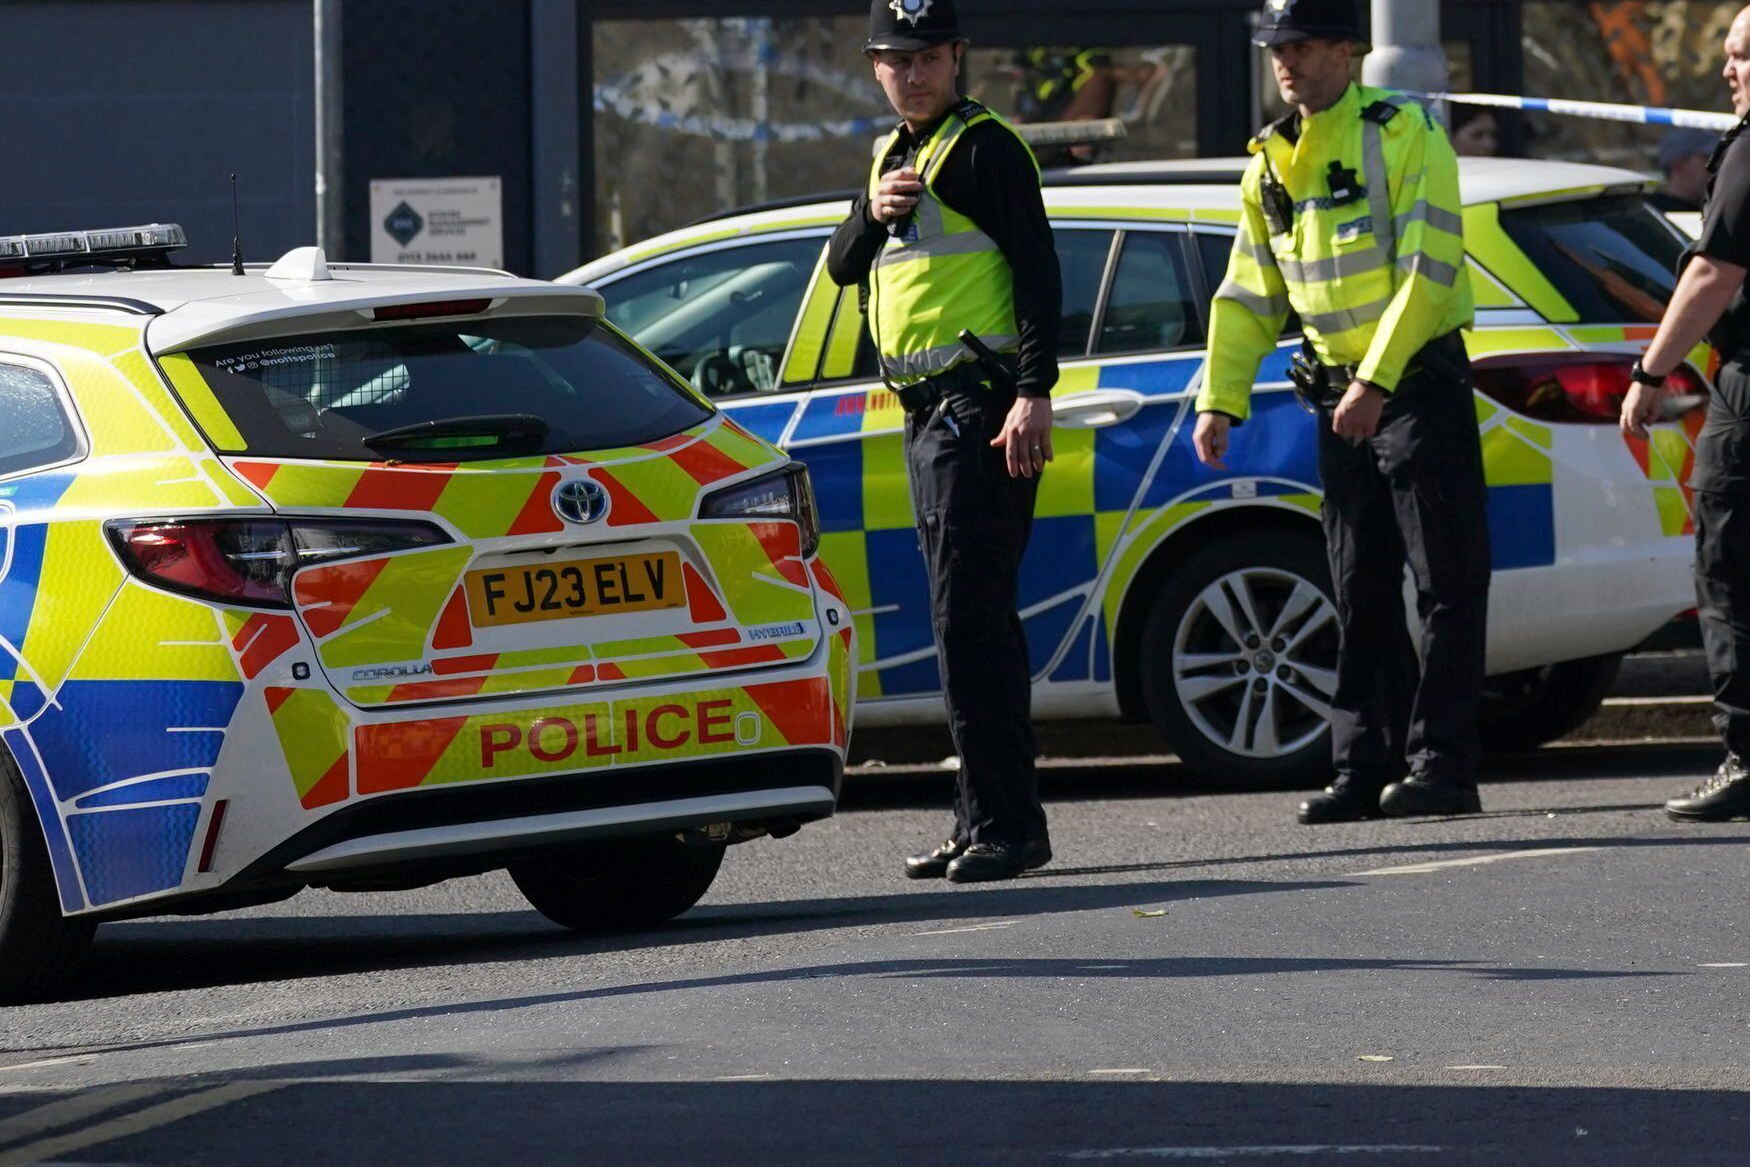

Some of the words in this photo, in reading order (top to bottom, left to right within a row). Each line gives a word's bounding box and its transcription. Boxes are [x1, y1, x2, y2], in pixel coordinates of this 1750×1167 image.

[215, 357, 235, 368] Are
[236, 352, 260, 363] you
[261, 344, 316, 358] following
[317, 343, 334, 353] us?
[259, 352, 336, 367] @nottspolice
[482, 566, 587, 616] FJ23
[593, 558, 665, 606] ELV
[479, 699, 735, 768] POLICE
